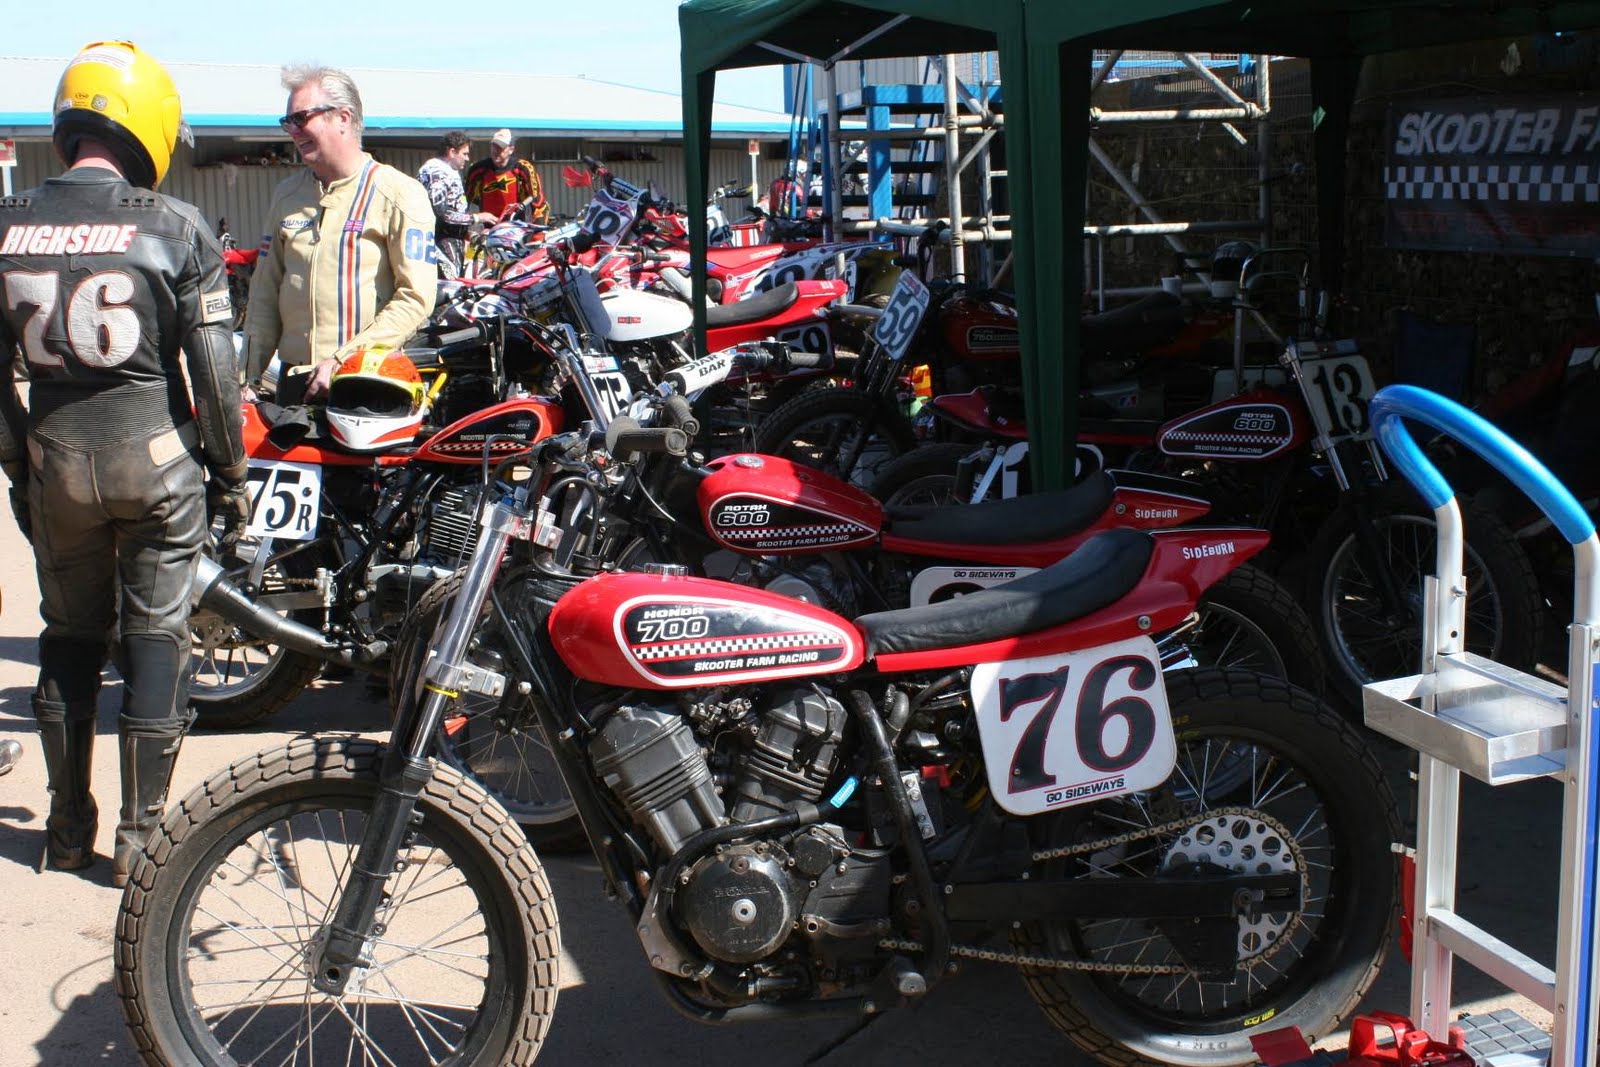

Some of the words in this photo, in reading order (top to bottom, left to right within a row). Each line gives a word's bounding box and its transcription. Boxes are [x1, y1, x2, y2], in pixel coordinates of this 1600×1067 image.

[1396, 108, 1561, 154] SKOOTER
[1, 225, 137, 255] HIGHSIDE
[2, 270, 140, 367] 76
[878, 287, 920, 350] 59
[699, 359, 726, 377] BAR
[1313, 364, 1369, 436] 13
[1234, 418, 1276, 432] 600
[717, 510, 770, 526] 600
[756, 540, 793, 548] SKOOTER
[795, 538, 818, 546] FARM
[819, 535, 850, 544] RACING
[1182, 542, 1235, 560] SIDEBURN
[643, 607, 705, 619] HONDA
[637, 615, 710, 643] 700
[694, 660, 743, 672] SKOOTER
[746, 656, 776, 668] FARM
[778, 652, 819, 664] RACING
[999, 654, 1156, 794] 76
[1046, 792, 1063, 804] GO
[1065, 778, 1125, 799] SIDEWAYS
